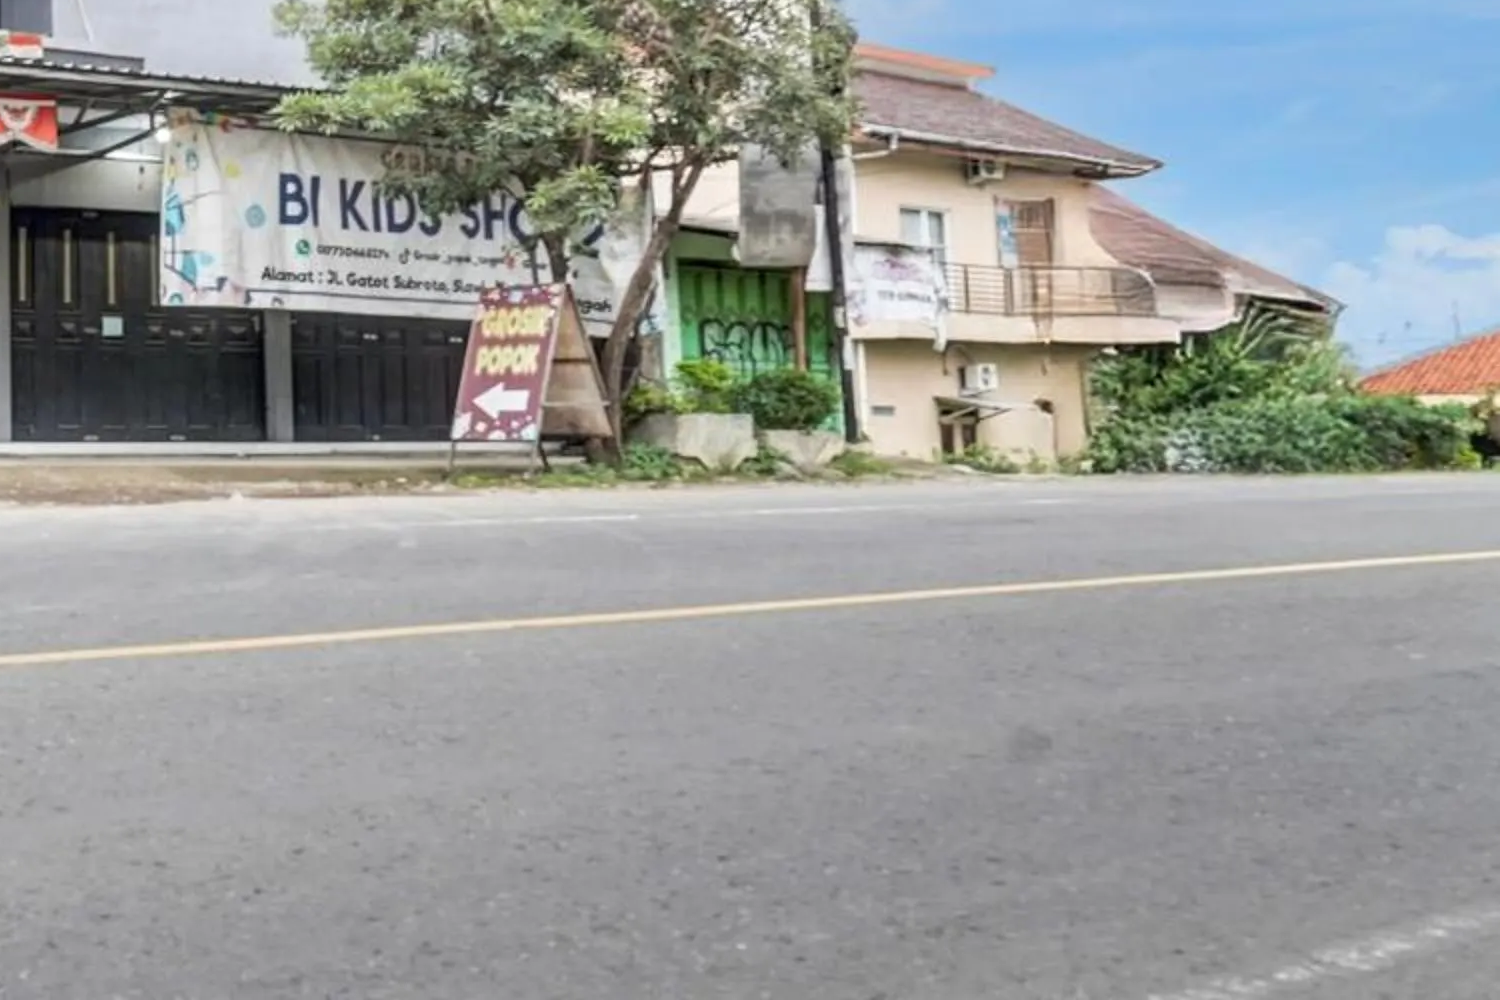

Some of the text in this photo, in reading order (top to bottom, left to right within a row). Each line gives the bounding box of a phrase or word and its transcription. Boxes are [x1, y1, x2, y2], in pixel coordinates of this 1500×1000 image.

[279, 173, 320, 228] BI
[339, 178, 441, 236] KIDS
[261, 266, 314, 283] Alamat
[346, 272, 390, 289] Gatot
[474, 343, 540, 376] POPOK
